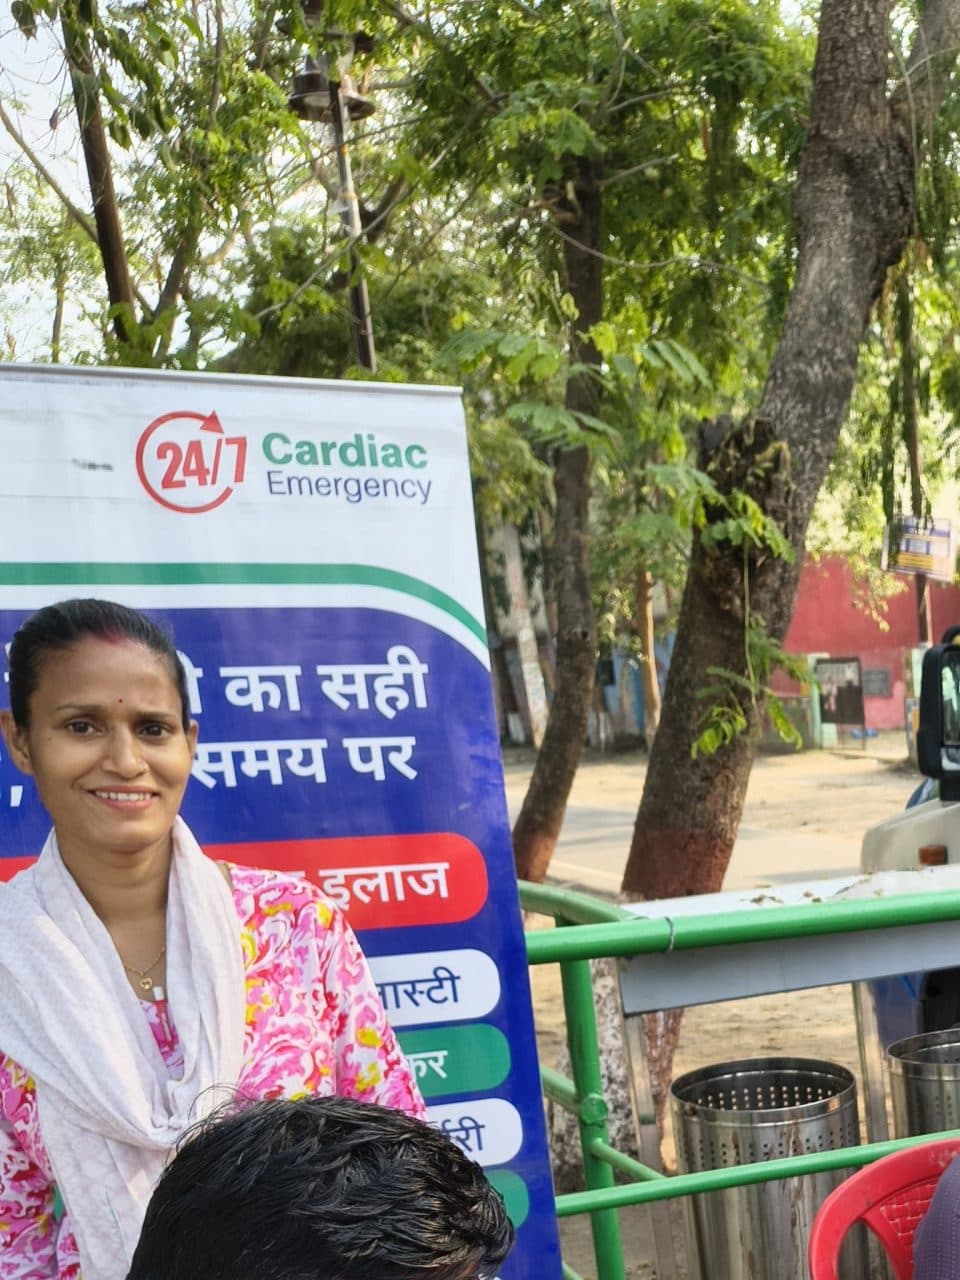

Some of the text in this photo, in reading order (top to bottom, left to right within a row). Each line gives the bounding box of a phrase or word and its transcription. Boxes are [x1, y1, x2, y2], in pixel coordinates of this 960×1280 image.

[156, 432, 428, 490] 24/7 Cardiac
[267, 470, 432, 504] Emergency
[219, 665, 302, 712] का
[316, 645, 429, 719] सही
[192, 736, 418, 789] समय पर
[318, 861, 450, 911] इलाज
